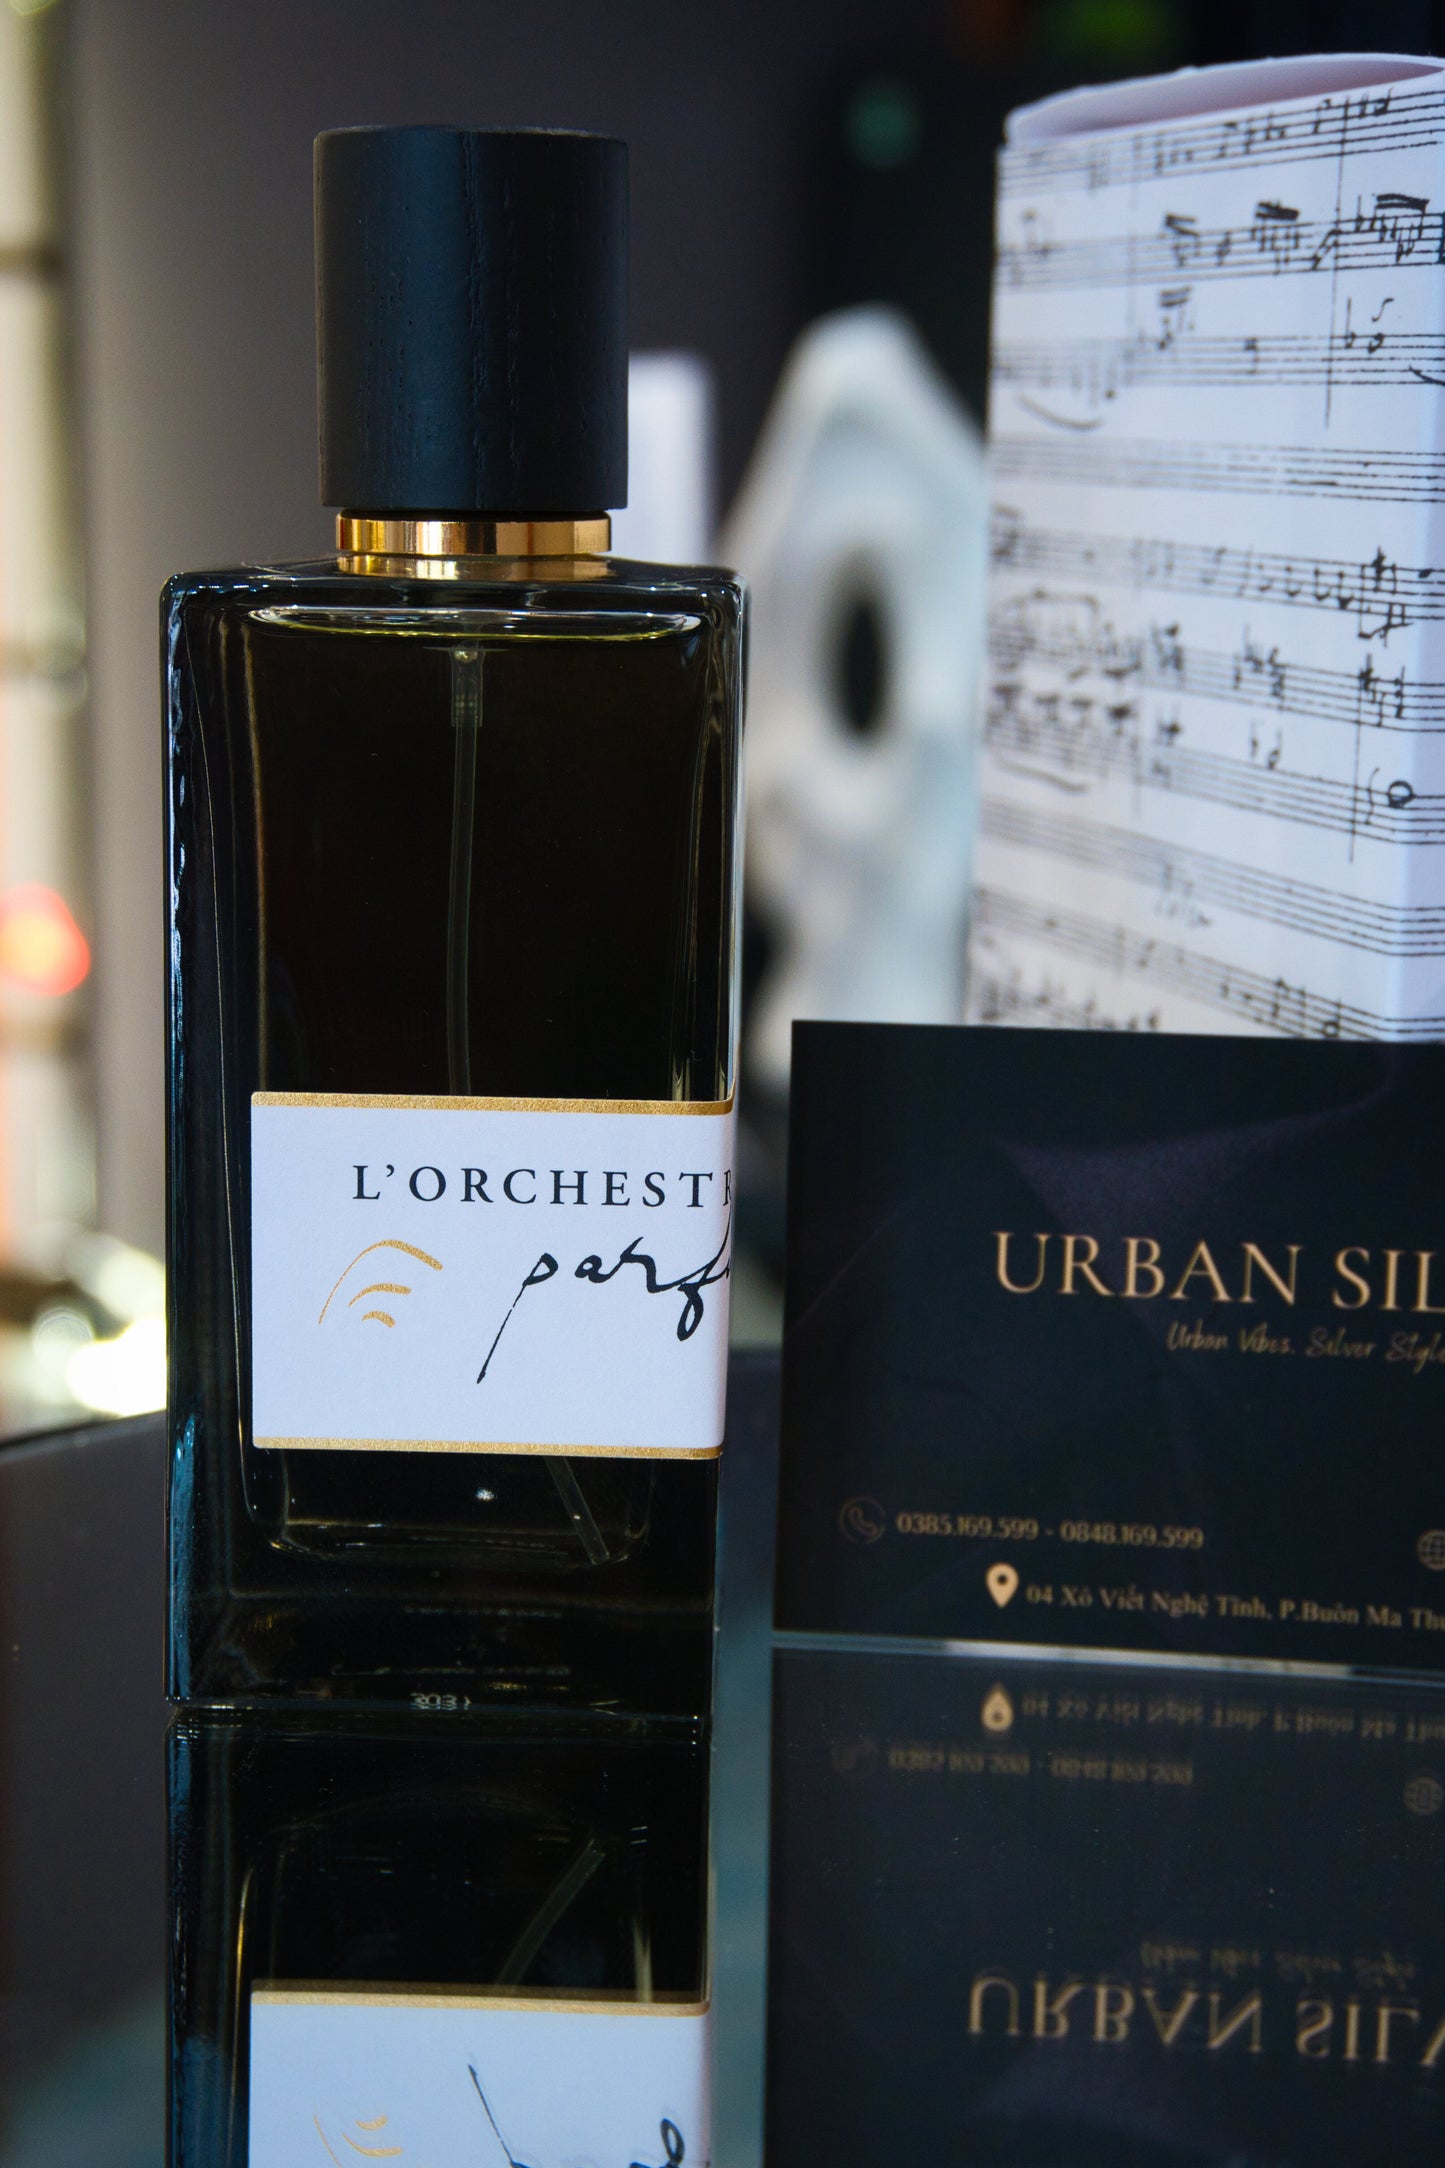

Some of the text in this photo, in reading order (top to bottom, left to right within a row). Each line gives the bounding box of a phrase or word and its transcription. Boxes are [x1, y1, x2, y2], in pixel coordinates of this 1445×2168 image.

[993, 1231, 1445, 1313] URBAN SIL
[476, 1204, 732, 1384] parf
[1166, 1318, 1228, 1352] Urban
[1304, 1325, 1376, 1359] Silver
[896, 1512, 1040, 1541] 0385.169.599
[1059, 1519, 1204, 1550] 0848.169.599
[1365, 1602, 1402, 1628] Ma
